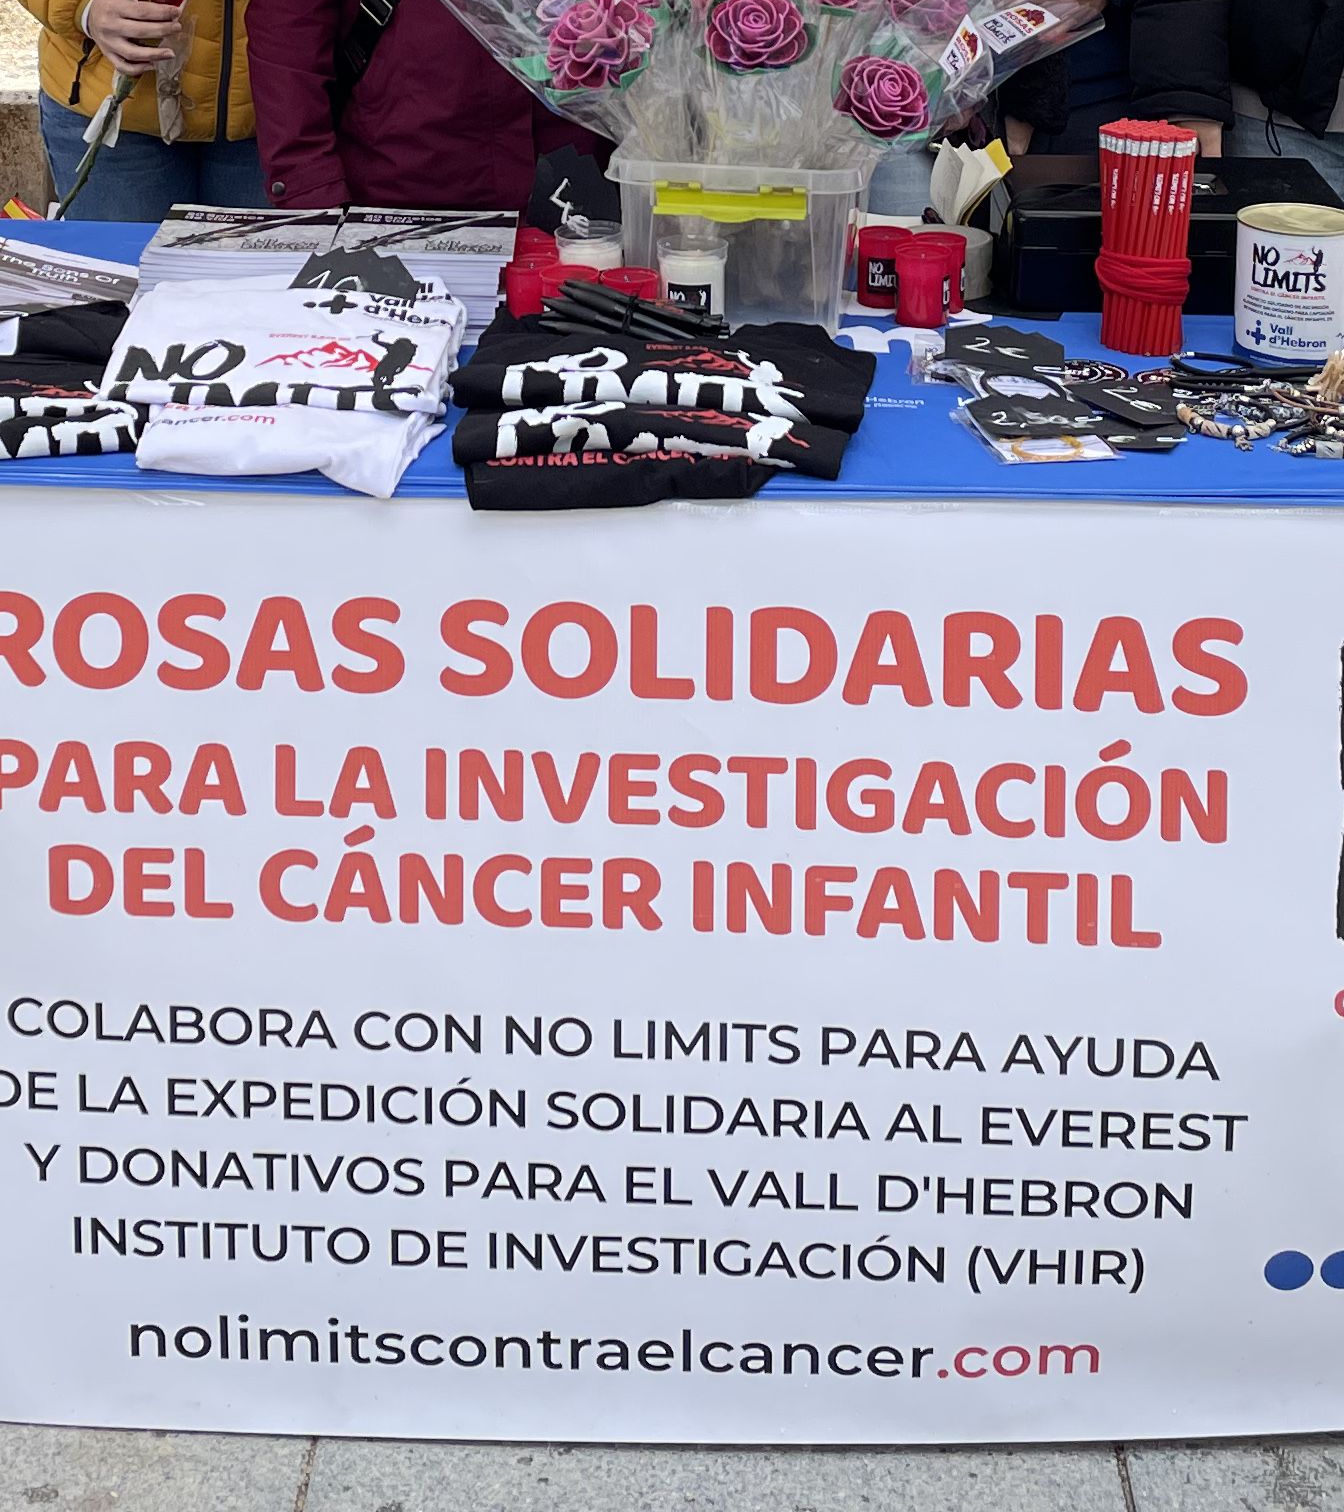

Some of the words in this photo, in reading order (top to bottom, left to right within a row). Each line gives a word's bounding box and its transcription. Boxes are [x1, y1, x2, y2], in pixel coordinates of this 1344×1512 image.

[1, 253, 36, 269] The
[40, 263, 89, 279] Sons
[95, 274, 122, 286] Of
[868, 262, 884, 275] NO
[1252, 263, 1327, 294] LIMITS
[1253, 242, 1281, 267] NO
[115, 338, 246, 383] NO
[1270, 322, 1293, 336] Vall
[440, 599, 1248, 716] SOLIDARIAS
[275, 744, 396, 819] LA
[426, 740, 1227, 843] INVESTIGACIÓN
[49, 844, 234, 918] DEL
[259, 825, 662, 931] CÁNCER
[693, 860, 1161, 948] INFANTIL
[8, 998, 337, 1048] COLABORA
[354, 1012, 481, 1053] CON
[506, 1016, 592, 1056] NO
[614, 1020, 800, 1064] LIMITS
[822, 1027, 986, 1072] PARA
[1002, 1035, 1219, 1080] AYUDA
[79, 1075, 148, 1114] LA
[168, 1079, 525, 1128] EXPEDICIÓN
[548, 1092, 870, 1140] SOLIDARIA
[885, 1104, 961, 1143] AL
[982, 1107, 1248, 1151] EVEREST
[25, 1144, 60, 1181] Y
[80, 1146, 424, 1196] DONATIVOS
[446, 1160, 606, 1202] PARA
[626, 1167, 692, 1205] EL
[708, 1170, 858, 1210] VALL
[878, 1175, 1192, 1218] D'HEBRON
[74, 1217, 369, 1264] INSTITUTO
[391, 1230, 467, 1268] DE
[490, 1233, 944, 1282] INVESTIGACIÓN
[969, 1246, 1143, 1293] (VHIR)
[131, 1314, 1099, 1378] nolimitscontraelcancer.com
